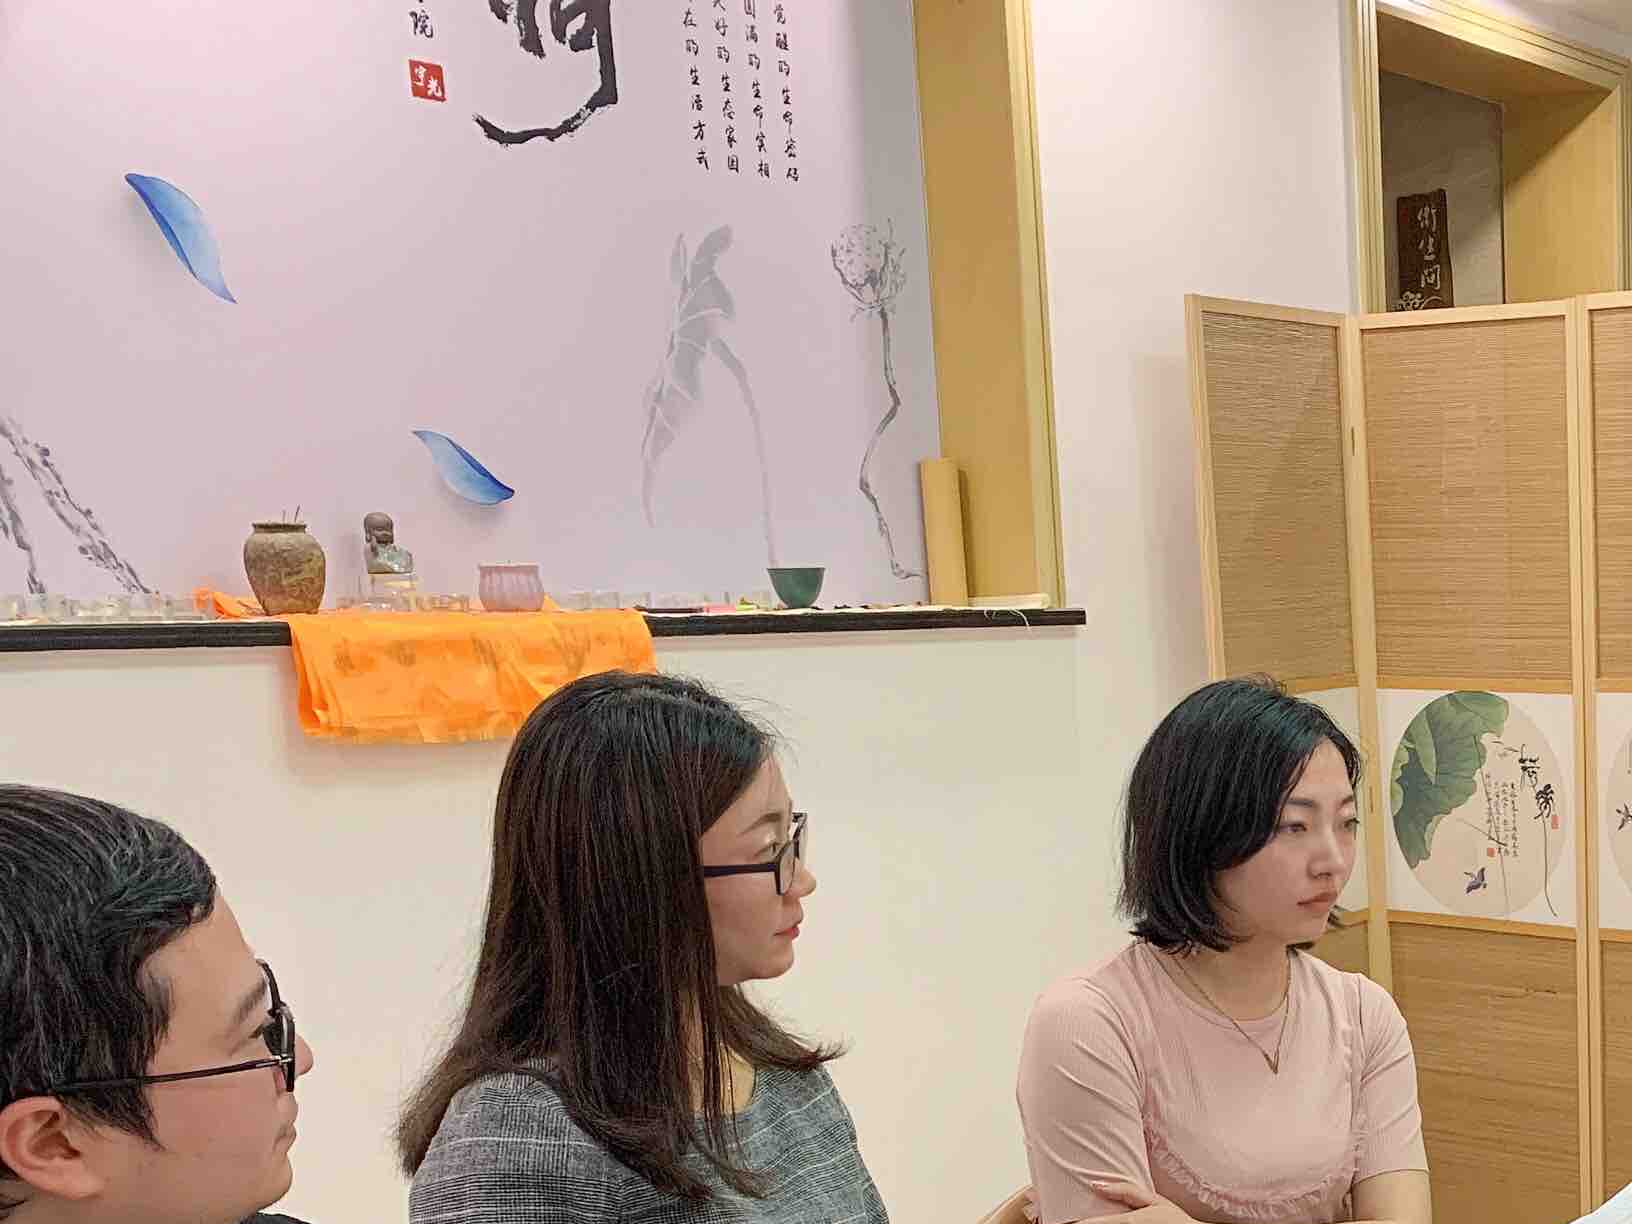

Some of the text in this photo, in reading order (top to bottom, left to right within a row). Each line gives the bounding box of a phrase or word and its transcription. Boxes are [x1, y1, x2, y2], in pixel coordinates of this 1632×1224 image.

[683, 0, 710, 171] 在的生活方式
